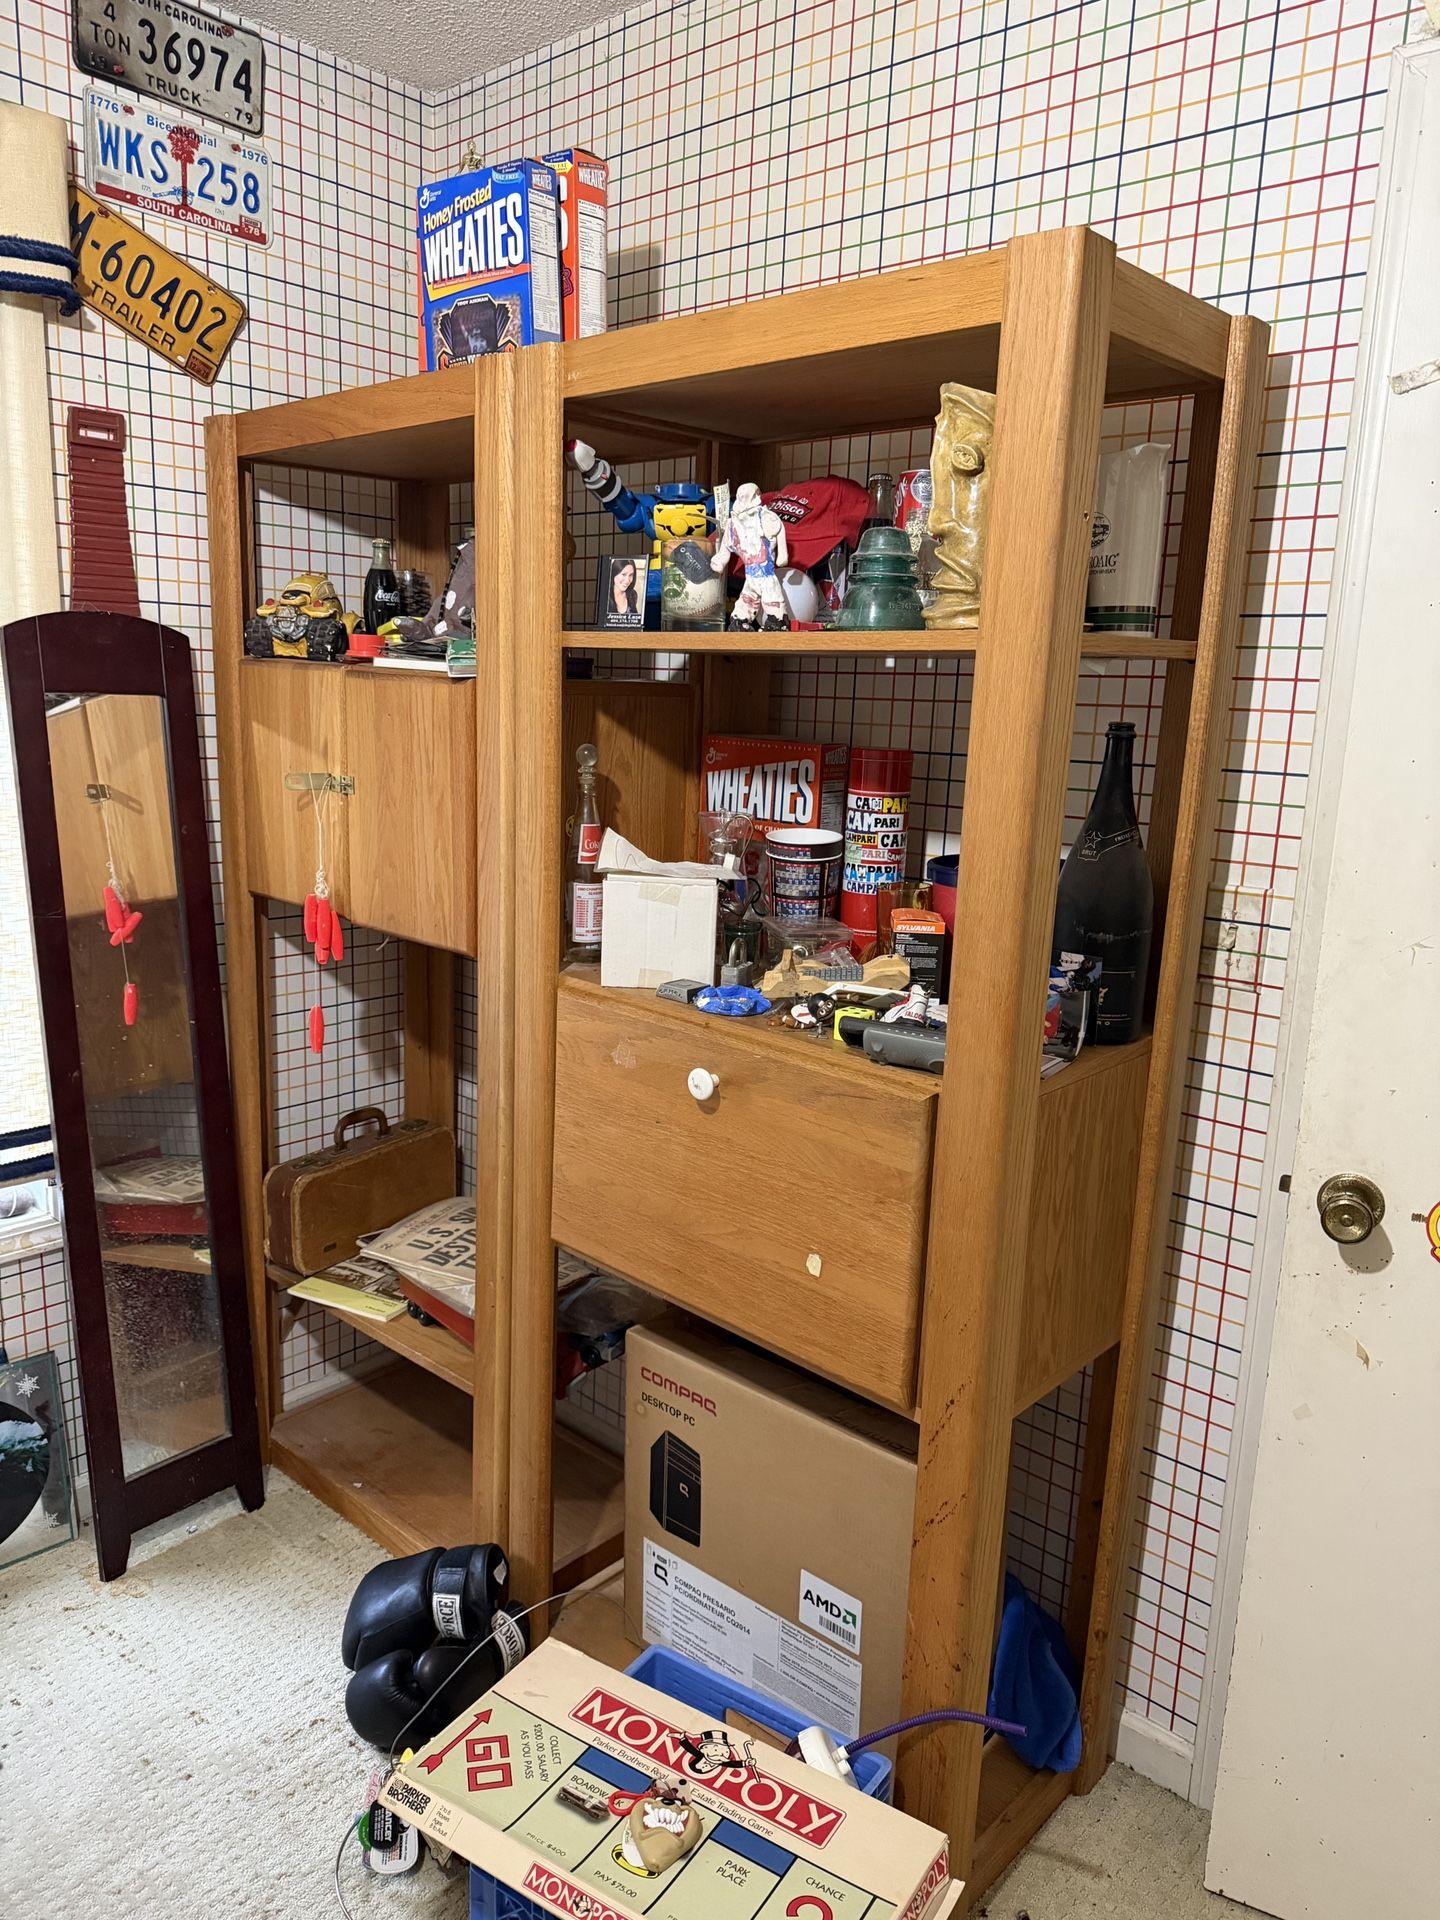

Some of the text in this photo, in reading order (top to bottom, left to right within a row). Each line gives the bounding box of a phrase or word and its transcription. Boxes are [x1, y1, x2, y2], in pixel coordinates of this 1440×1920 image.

[103, 3, 117, 22] 4
[165, 4, 224, 39] CAROLINA
[90, 20, 131, 56] TON
[138, 18, 253, 104] 36974
[90, 94, 119, 114] 1776
[145, 73, 202, 107] TRUCK
[234, 107, 253, 125] 79
[98, 119, 261, 215] WKS 258
[241, 148, 268, 165] 1976
[578, 167, 606, 192] WHEATIES
[136, 196, 175, 217] SOUTH
[178, 208, 233, 234] CAROLINA
[423, 178, 492, 234] Honey Frosted
[424, 192, 524, 284] WHEATIES
[90, 280, 176, 352] TRAILER
[707, 758, 816, 825] WHEATIES
[847, 810, 900, 832] CAMPARI
[846, 832, 876, 844] CAMPARI
[896, 924, 936, 932] SYLVANIA
[641, 1366, 718, 1418] COMPAQ
[641, 1392, 696, 1427] DESKTOP PC
[674, 1575, 736, 1617] COMPAQ PRESARIO
[803, 1589, 842, 1619] AMD
[466, 1735, 513, 1792] GO
[520, 1730, 535, 1780] AS YOU PASS
[549, 1735, 562, 1766] COLLECT
[576, 1693, 838, 1836] MONOPOLY
[537, 1754, 550, 1783] SALARY
[387, 1786, 427, 1816] BROTHERS
[401, 1783, 431, 1808] PARKER
[592, 1736, 775, 1838] Parker Brothers Real Estate Trading Game
[526, 1832, 567, 1857] PRICE $400
[593, 1870, 638, 1898] PAY $75.00
[715, 1866, 747, 1888] PLACE
[724, 1859, 751, 1879] PARK
[805, 1876, 847, 1903] CHANCE
